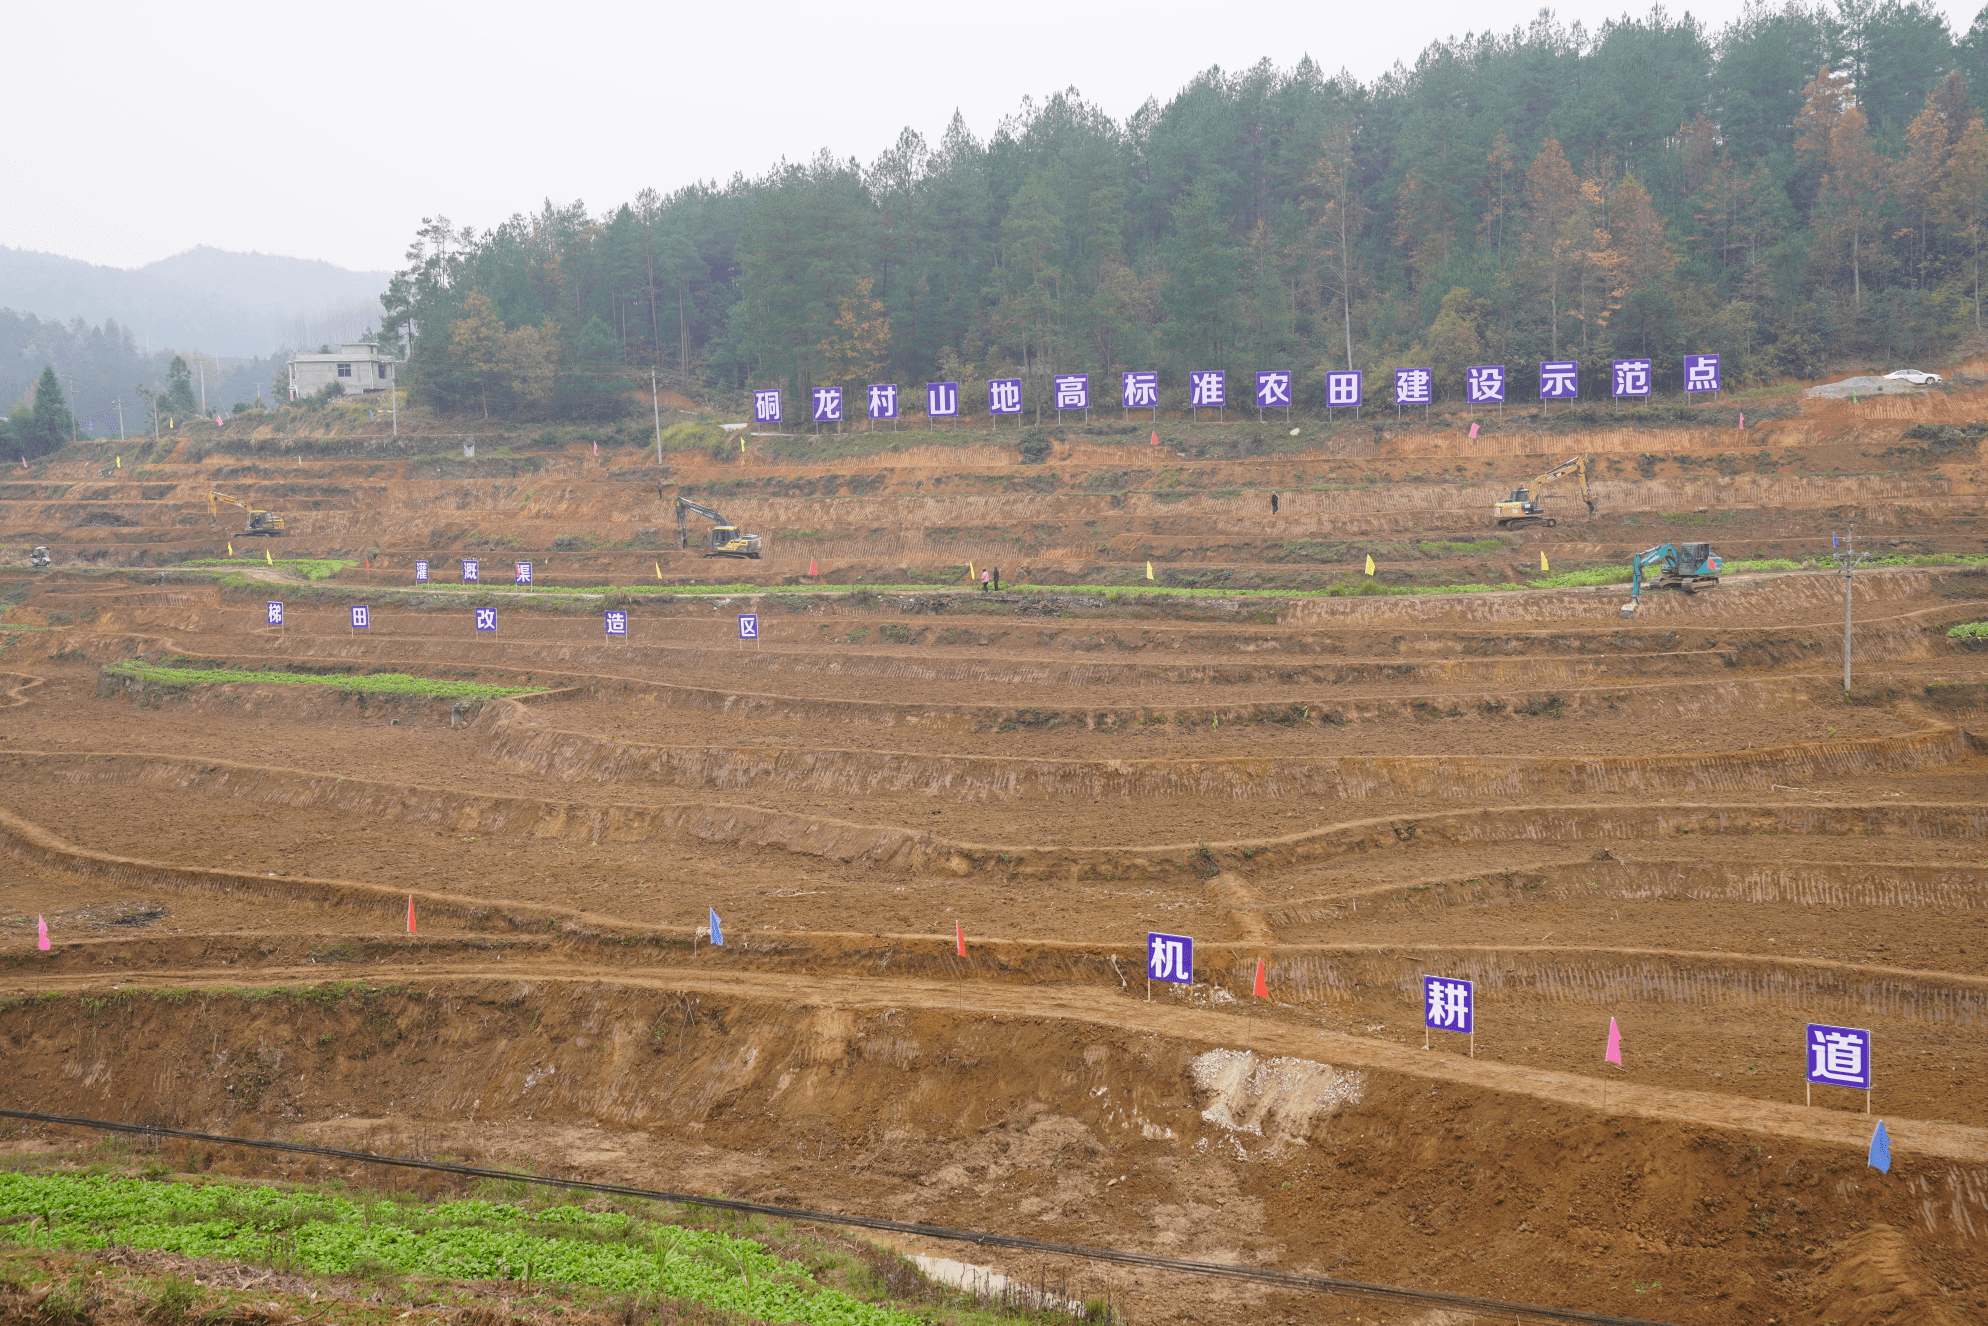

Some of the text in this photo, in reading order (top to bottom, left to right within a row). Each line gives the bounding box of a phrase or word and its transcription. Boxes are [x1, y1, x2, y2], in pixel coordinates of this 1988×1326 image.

[756, 357, 1717, 420] 硐 龙 村 山 地 高 标 准 农 田 建 设 示 范 点
[269, 604, 756, 636] 梯 田 改 造 区
[1151, 938, 1863, 1083] 机 耕 道
